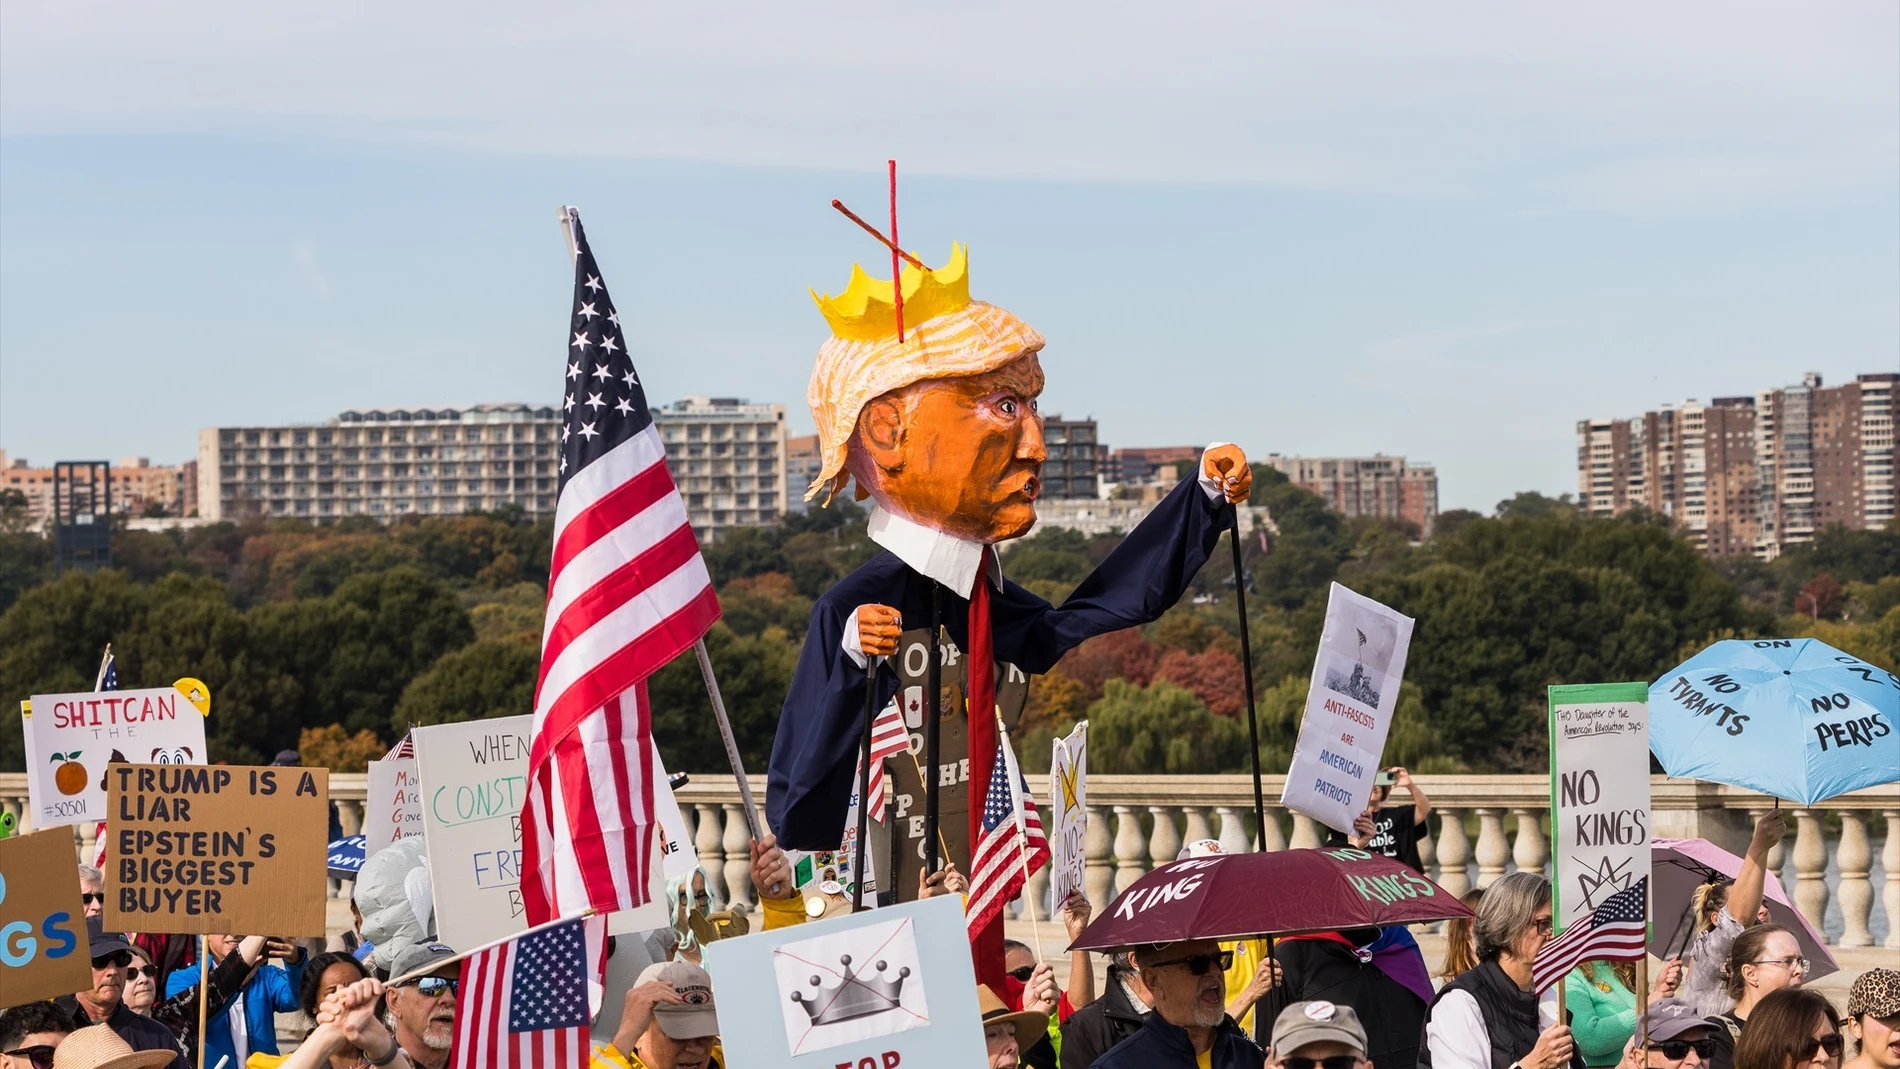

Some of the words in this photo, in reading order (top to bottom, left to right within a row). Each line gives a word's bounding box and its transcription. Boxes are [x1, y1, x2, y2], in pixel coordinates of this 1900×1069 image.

[1702, 674, 1741, 694] NO
[54, 694, 175, 729] SHITCAN
[1323, 698, 1376, 731] ANTI-FASCISTS
[1575, 708, 1606, 726] Daughter
[1608, 707, 1615, 718] of
[1618, 708, 1629, 718] the
[1669, 676, 1751, 736] TYRANTS
[1811, 692, 1850, 714] NO
[91, 725, 138, 740] THE
[1341, 732, 1354, 747] ARE
[1564, 724, 1592, 736] American
[1595, 721, 1624, 732] Revolution
[1628, 721, 1644, 734] says:
[1813, 713, 1890, 752] PERPS
[469, 734, 532, 764] WHEN
[1319, 748, 1363, 780] AMERICAN
[116, 767, 231, 795] TRUMP
[250, 770, 278, 796] IS
[296, 771, 317, 797] A
[1314, 778, 1353, 807] PATRIOTS
[1561, 769, 1600, 808] NO
[44, 799, 87, 818] #50501
[119, 795, 191, 822] LIAR
[393, 789, 419, 805] Are
[119, 826, 276, 858] EPSTEIN'S
[1576, 809, 1646, 846] KINGS
[1064, 826, 1078, 867] NO
[1328, 848, 1372, 862] NO
[119, 858, 255, 886] BIGGEST
[1166, 857, 1225, 874] NO
[1057, 859, 1083, 903] KINGS
[1346, 869, 1436, 907] KINGS
[119, 887, 222, 915] BUYER
[1113, 872, 1205, 921] KING
